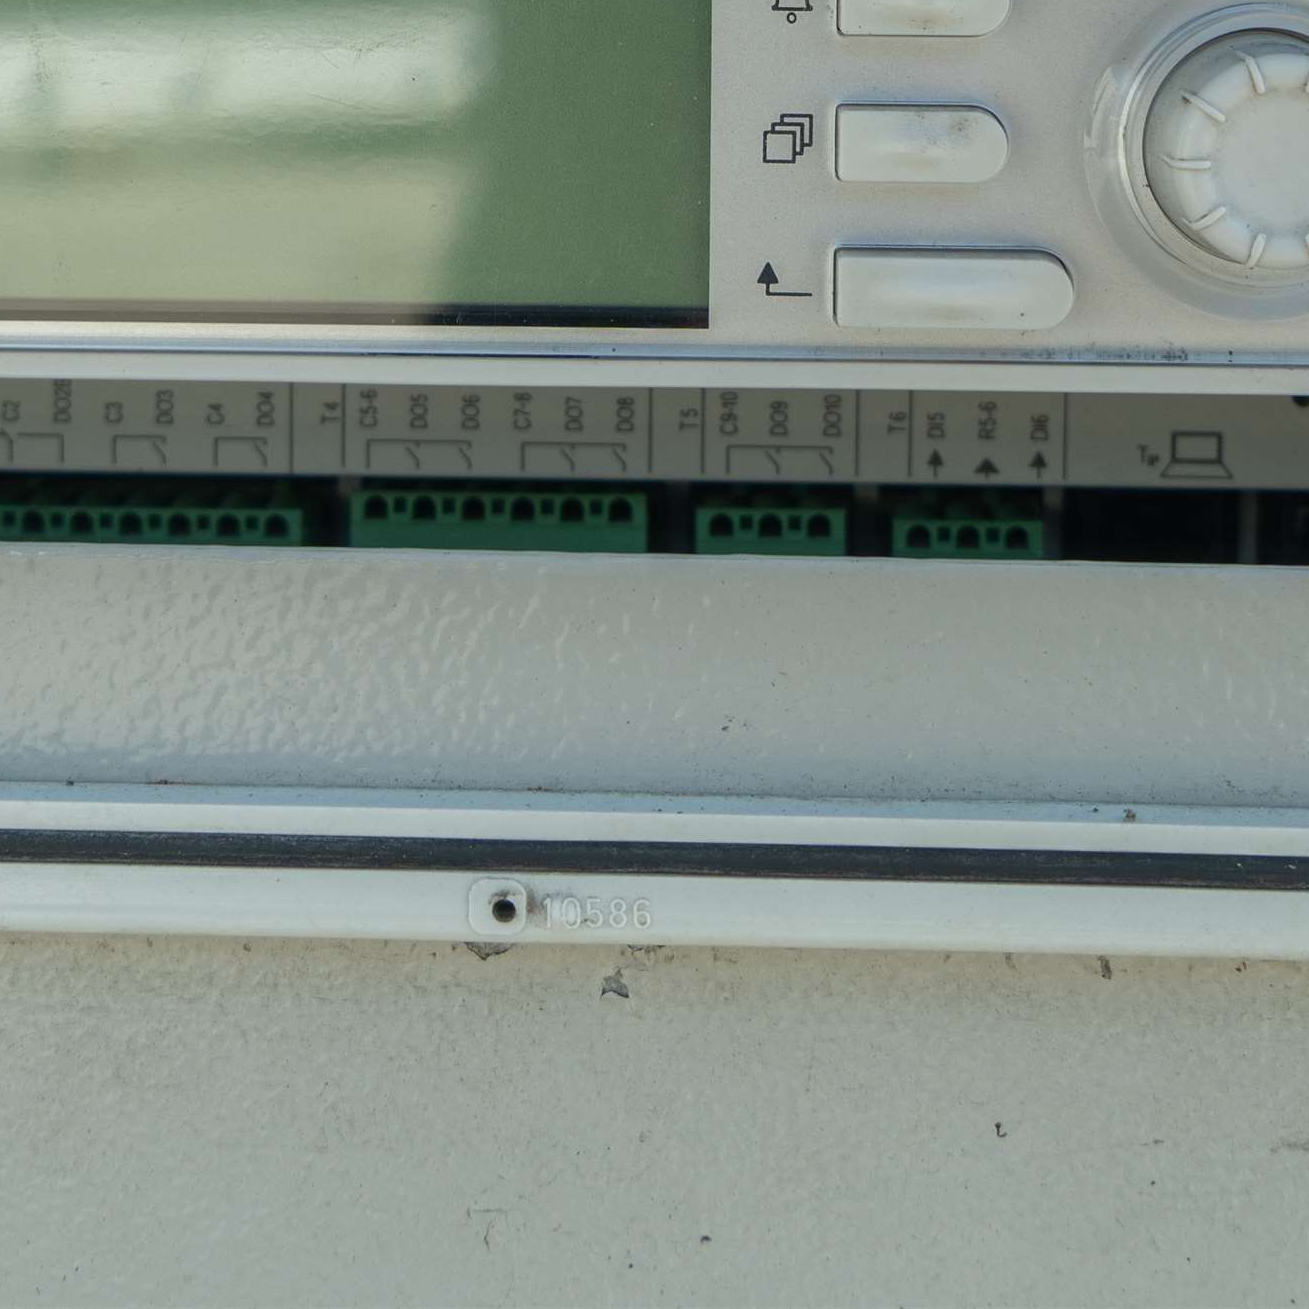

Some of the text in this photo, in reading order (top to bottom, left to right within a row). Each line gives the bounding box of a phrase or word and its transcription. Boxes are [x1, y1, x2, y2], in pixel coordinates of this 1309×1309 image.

[104, 400, 124, 425] C3
[155, 389, 175, 426] DO3
[206, 402, 226, 427] C4
[256, 391, 276, 428] DO4
[320, 401, 340, 426] T4
[359, 389, 378, 428] C5-6
[410, 393, 429, 430] DO5
[462, 394, 481, 431] DO6
[513, 392, 532, 431] C7-8
[565, 396, 584, 433] DO7
[616, 396, 636, 433] DO8
[679, 408, 699, 432] T5
[770, 400, 789, 437] DO9
[823, 394, 843, 438] DO10
[887, 411, 907, 435] T6
[927, 411, 946, 440] DI5
[1031, 413, 1050, 442] DI6
[543, 897, 652, 930] 10586
